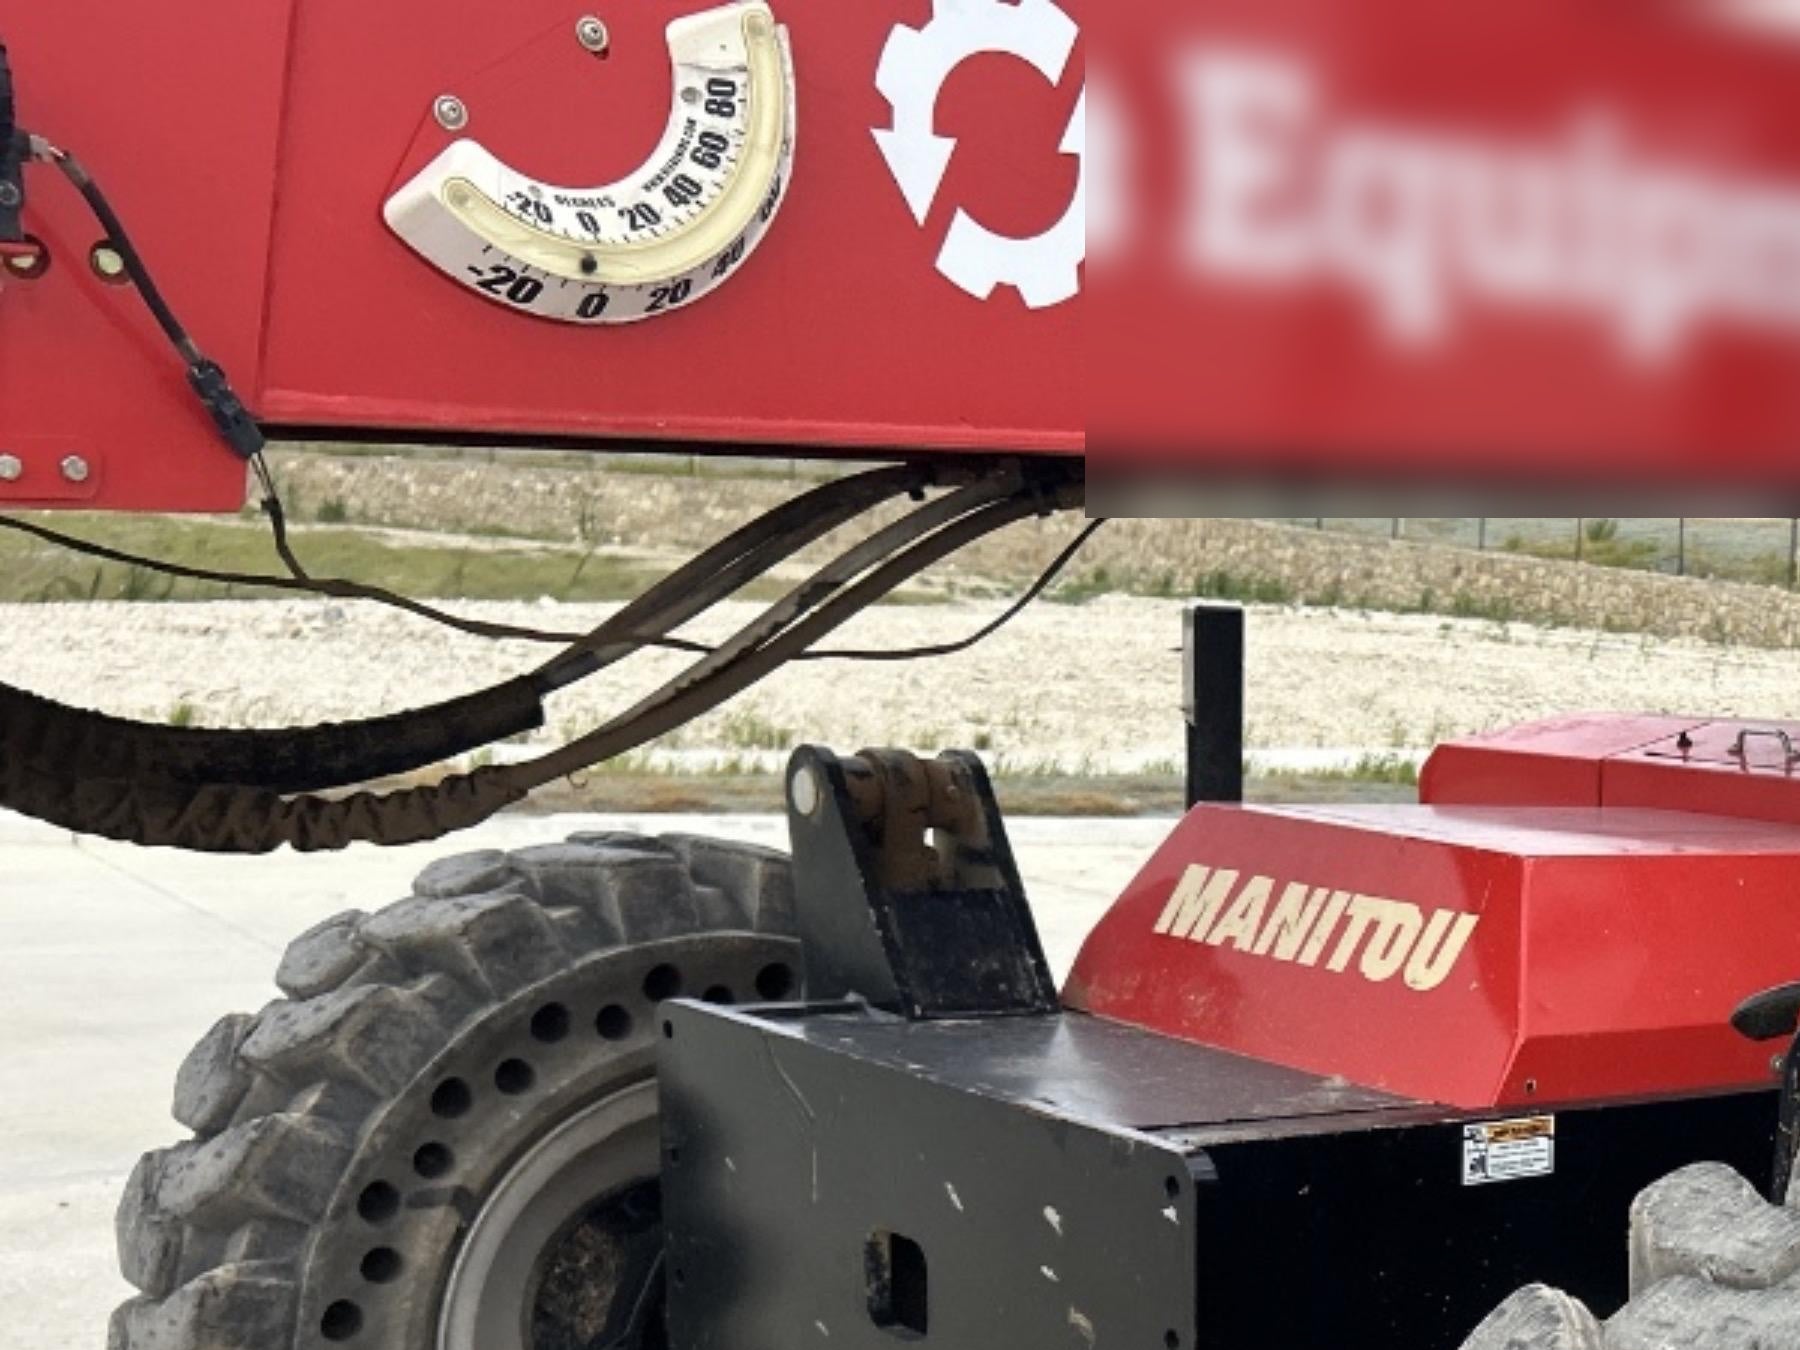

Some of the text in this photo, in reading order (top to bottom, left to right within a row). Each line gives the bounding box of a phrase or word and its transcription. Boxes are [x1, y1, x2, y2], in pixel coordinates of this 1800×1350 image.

[705, 78, 737, 118] 80
[690, 131, 729, 170] 60
[663, 173, 703, 207] 40
[576, 211, 600, 234] 0
[618, 202, 661, 231] 20
[467, 265, 544, 304] -20
[575, 292, 609, 318] 0
[645, 278, 692, 312] 20
[1153, 863, 1480, 991] MANITOU
